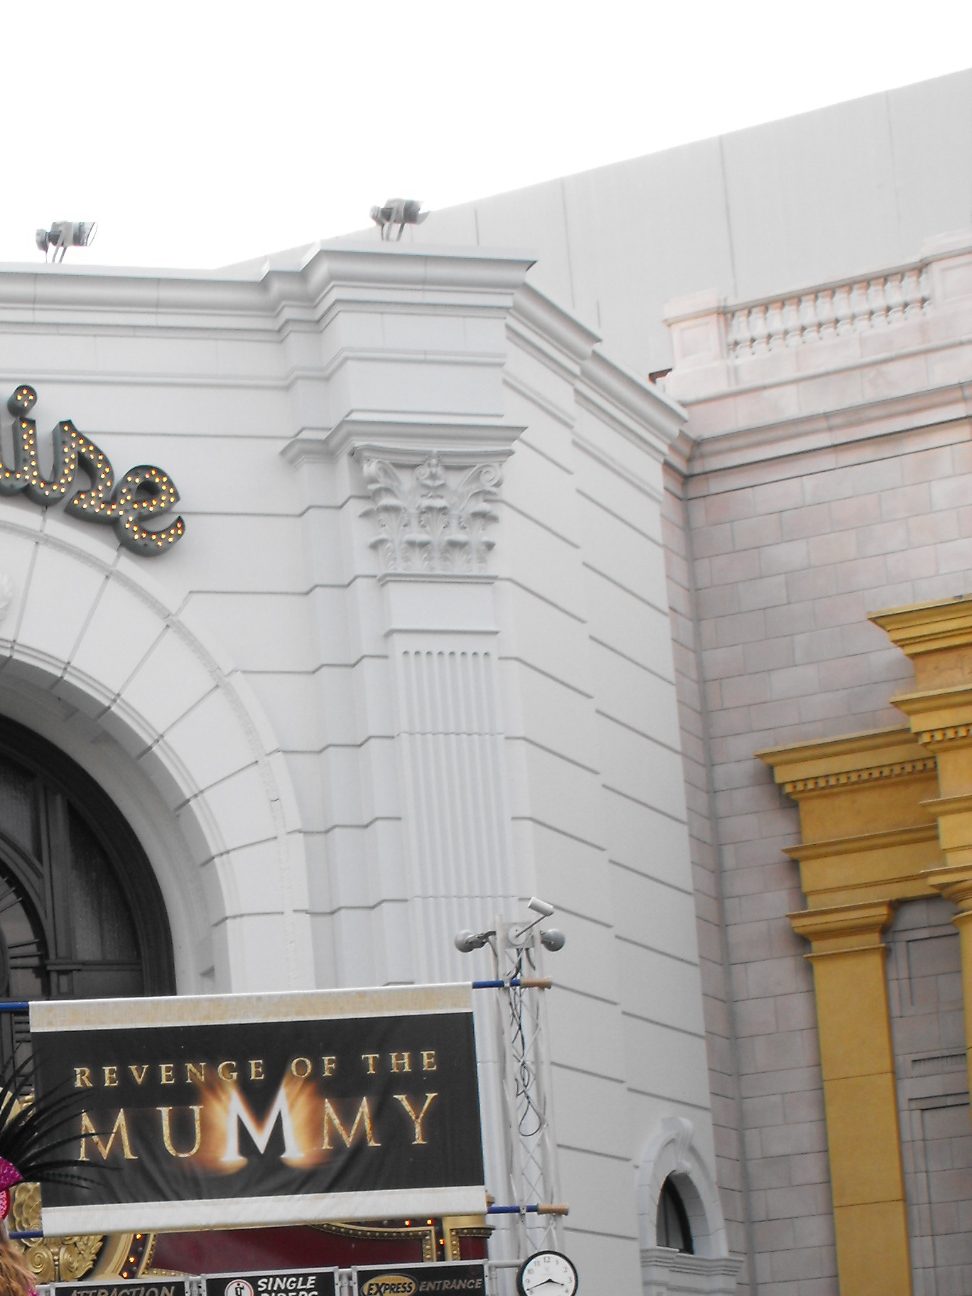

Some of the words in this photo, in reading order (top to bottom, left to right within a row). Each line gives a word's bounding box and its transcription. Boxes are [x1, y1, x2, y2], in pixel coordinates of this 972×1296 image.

[73, 1060, 265, 1088] REVENGE
[290, 1056, 337, 1078] OF
[361, 1051, 438, 1075] THE
[77, 1088, 439, 1163] MUMMY
[257, 1276, 316, 1291] SINGLE
[419, 1279, 483, 1292] ENTRANCE
